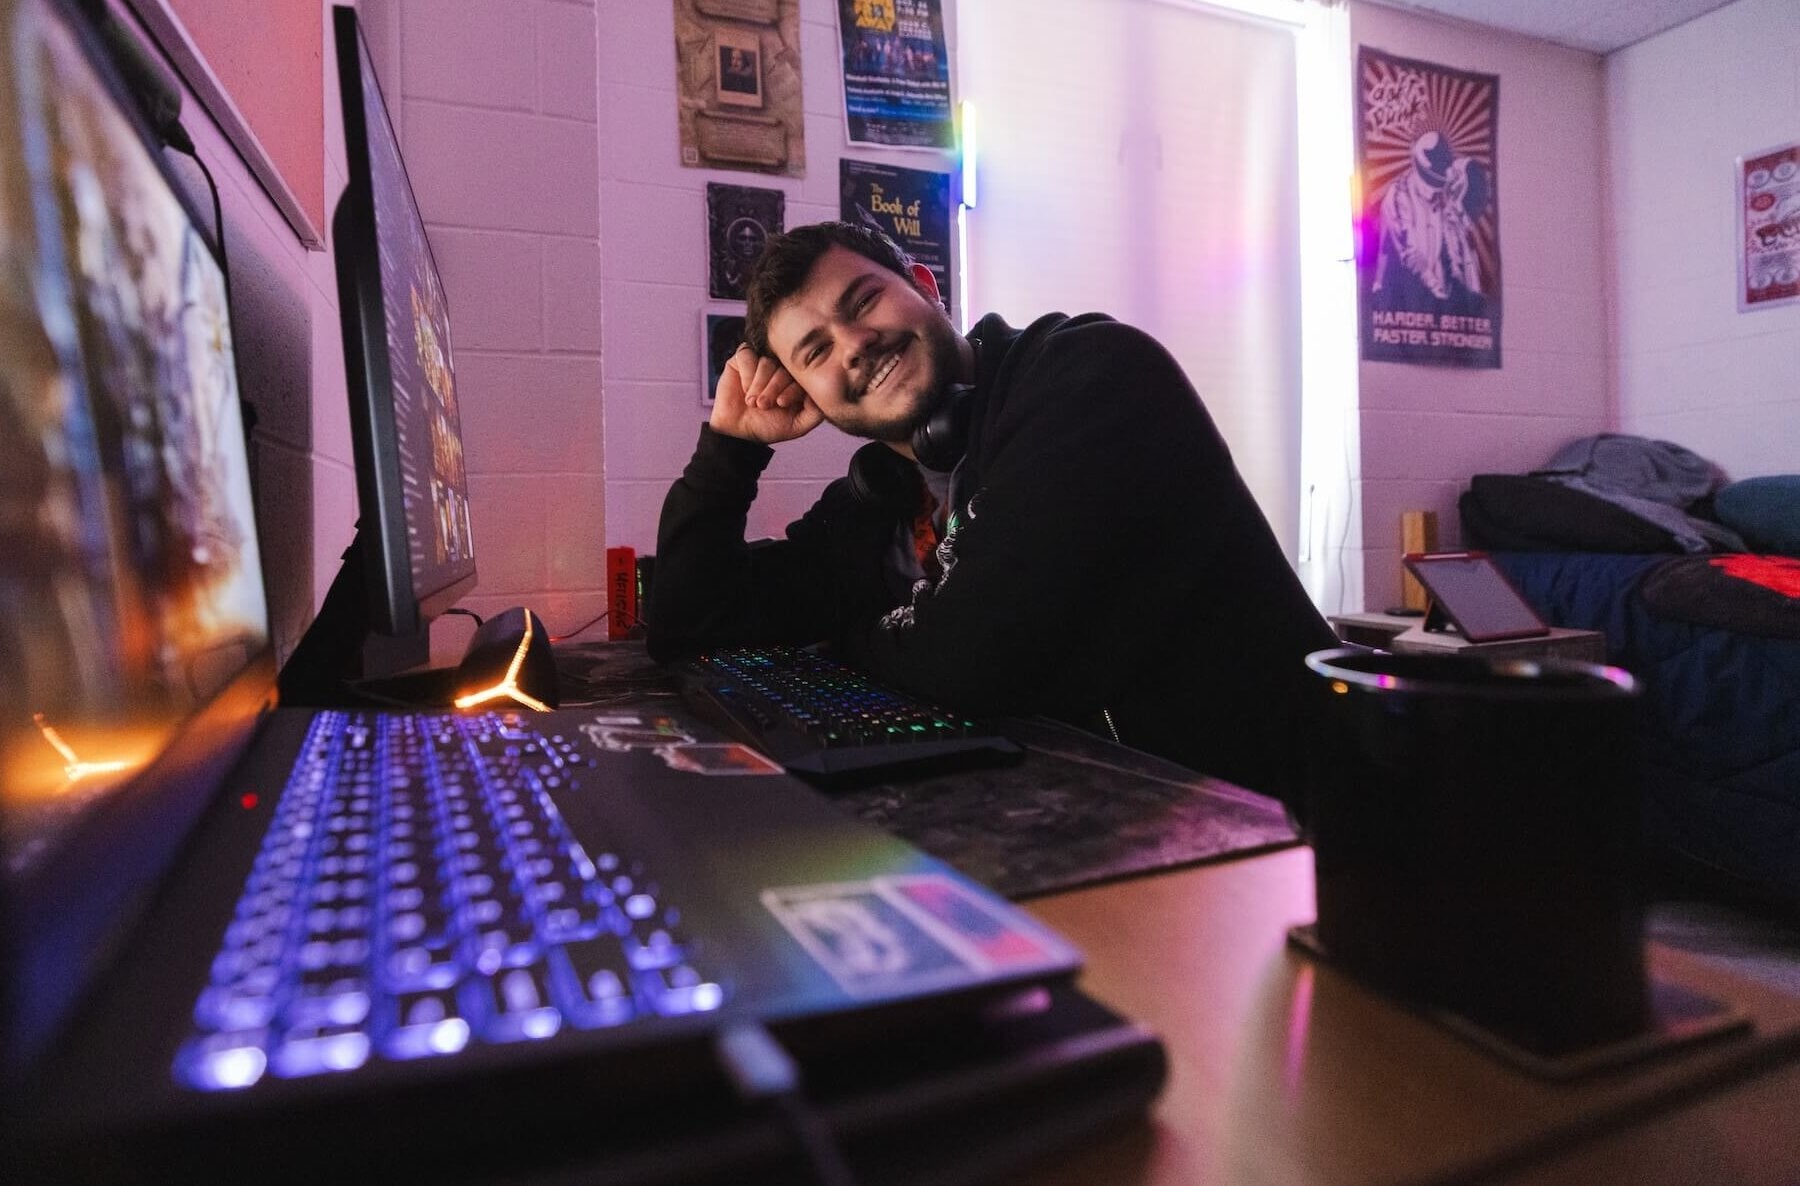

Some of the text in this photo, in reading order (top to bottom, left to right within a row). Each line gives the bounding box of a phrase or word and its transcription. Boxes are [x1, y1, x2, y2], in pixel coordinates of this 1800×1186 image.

[870, 182, 884, 194] The
[871, 194, 921, 216] Book of
[893, 217, 921, 236] Will
